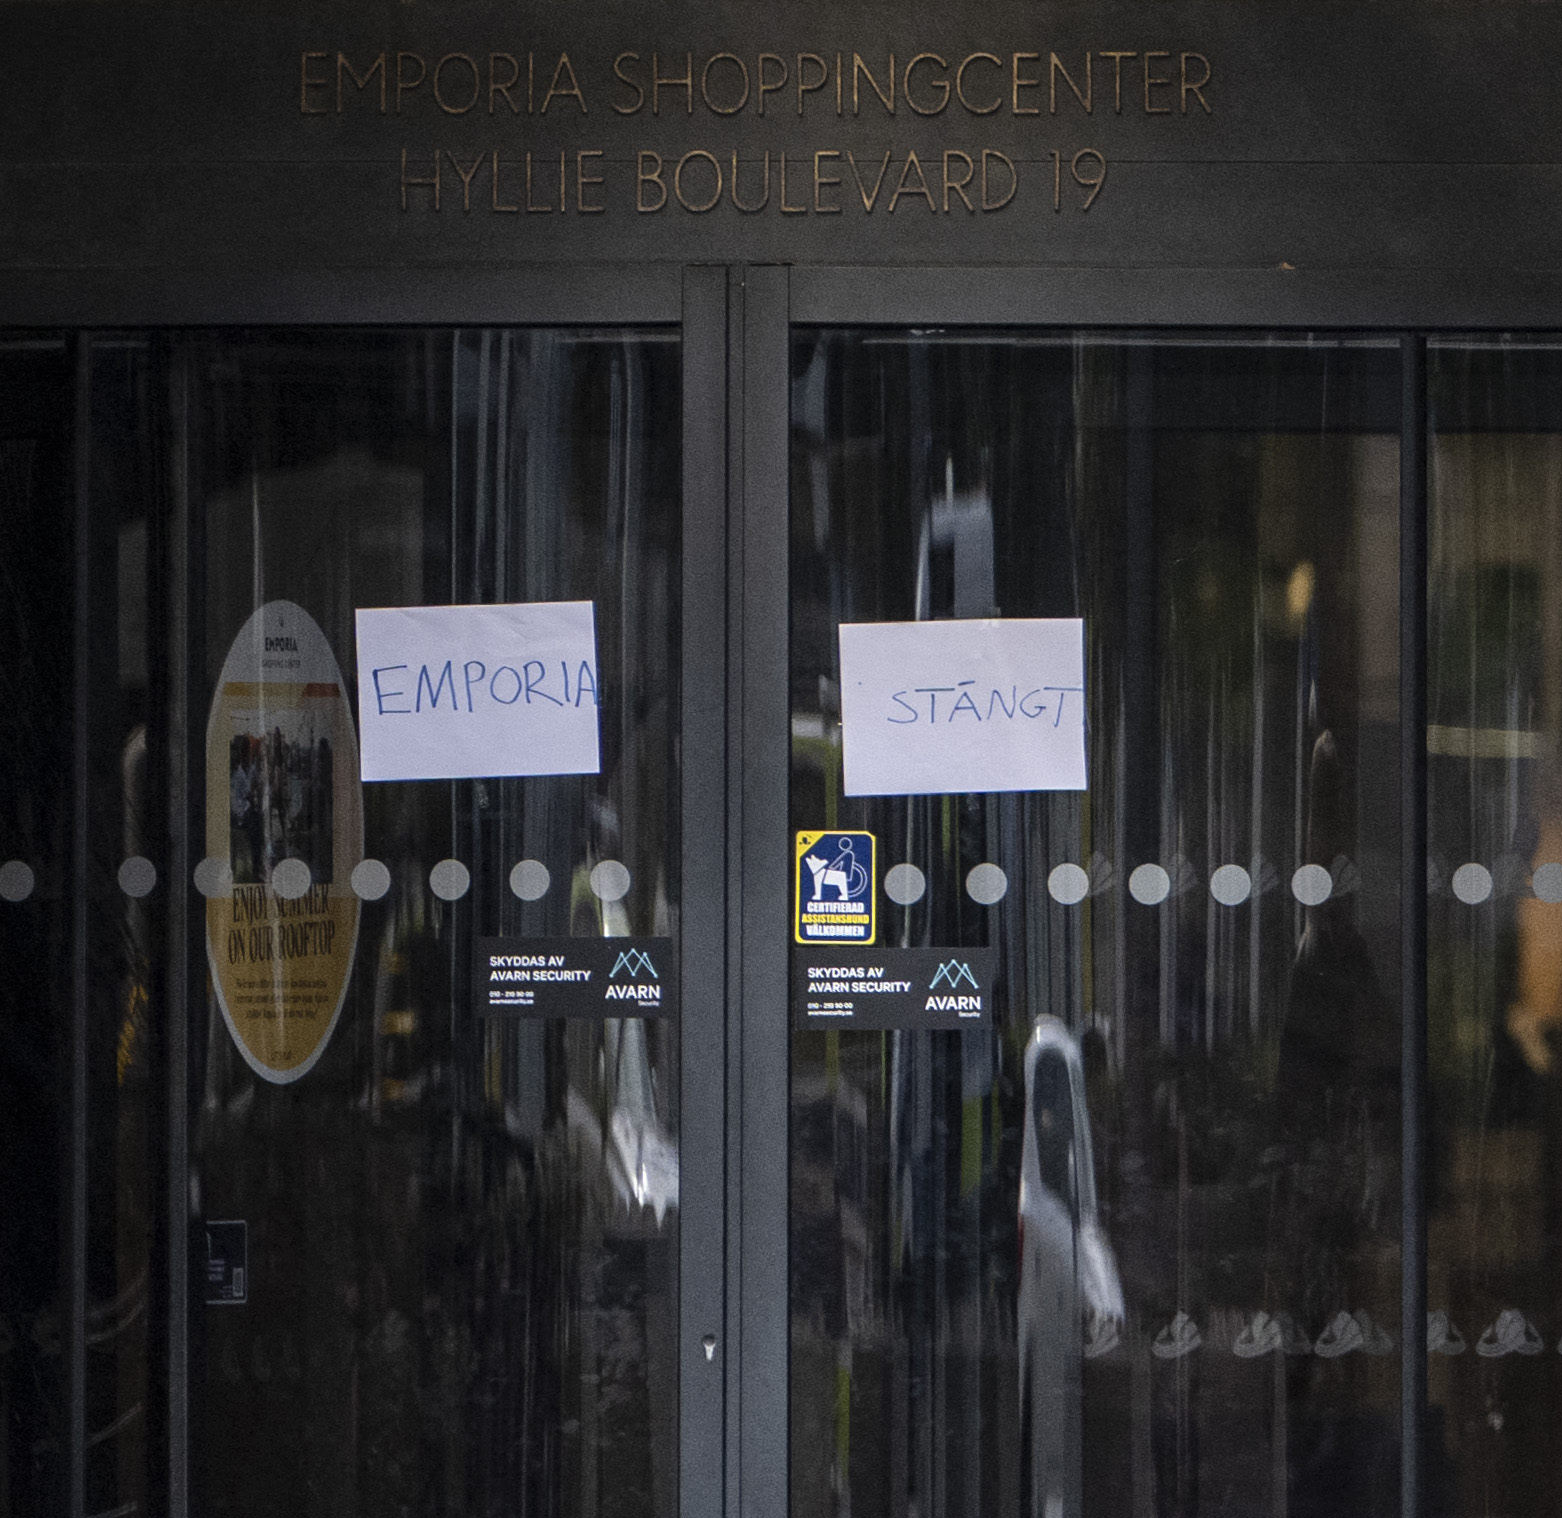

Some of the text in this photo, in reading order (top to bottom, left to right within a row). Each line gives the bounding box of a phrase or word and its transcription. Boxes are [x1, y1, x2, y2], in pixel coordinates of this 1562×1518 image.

[300, 50, 1213, 116] EMPORIA SHOPPINGCENTER
[400, 148, 1108, 214] HYLLIE BOULEVARD 19
[372, 660, 600, 716] EMPORIA
[232, 885, 270, 926] ENJOY
[806, 901, 865, 913] CERTIFIERAD
[805, 923, 866, 937] VÄLKOMMEN
[228, 919, 336, 965] ON OUR ROOFTOP
[489, 955, 566, 967] SKYDDAS AV
[489, 970, 592, 981] AVARN SECURITY
[807, 967, 885, 979] SKYDDAS AV
[604, 984, 661, 1000] AVARN
[807, 981, 912, 993] AVARN SECURITY
[924, 996, 982, 1011] AVARN
